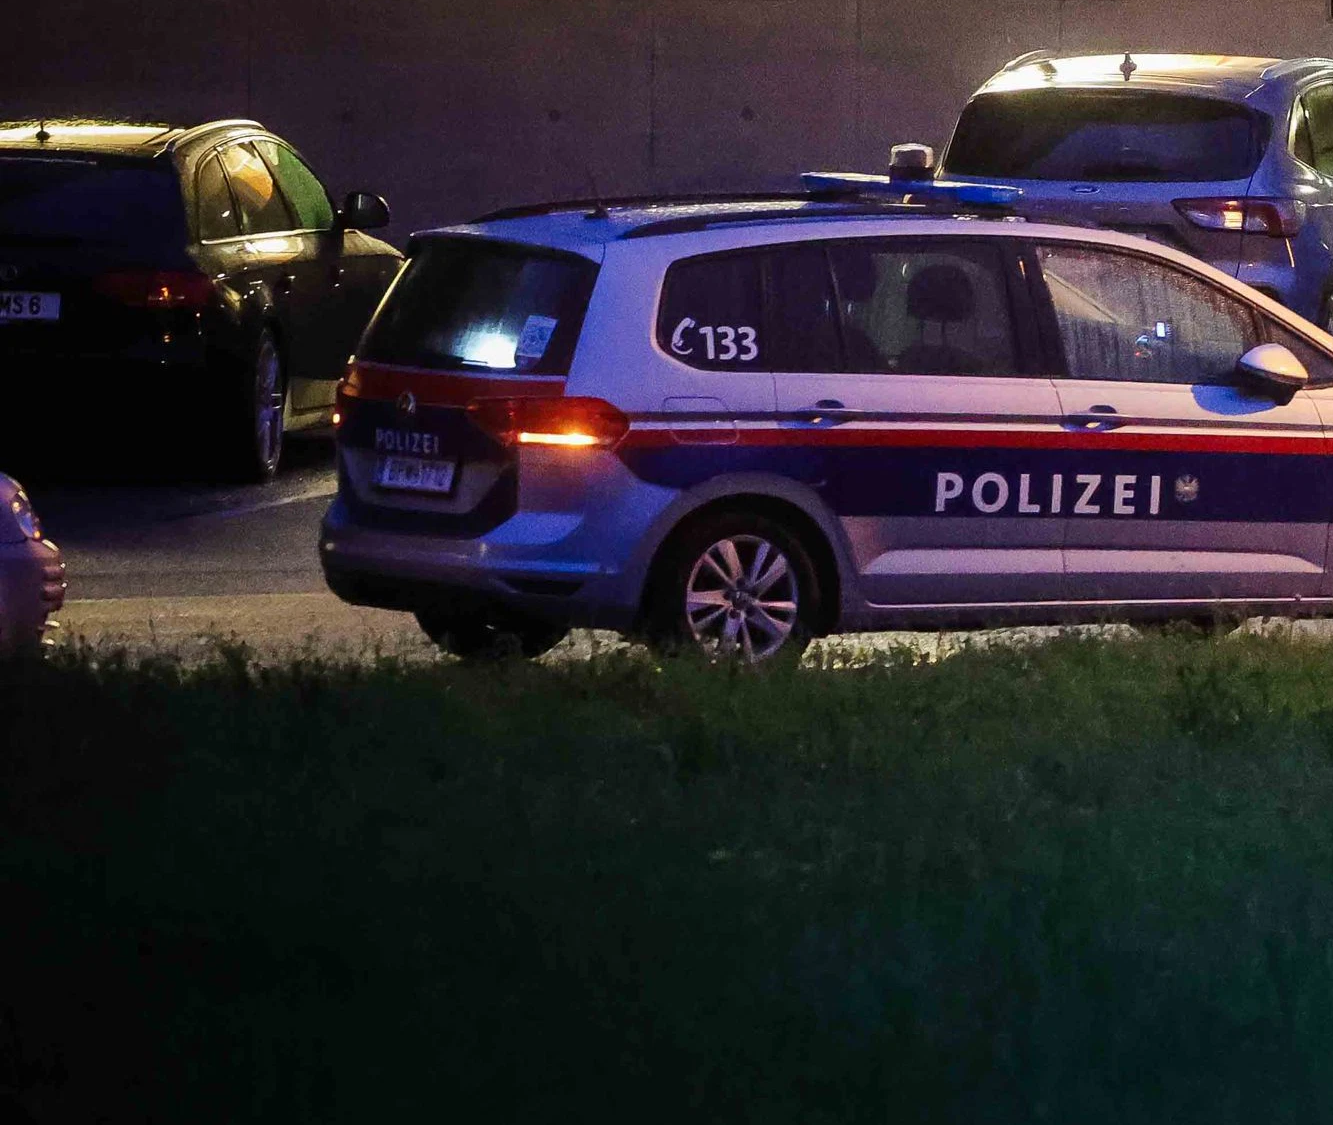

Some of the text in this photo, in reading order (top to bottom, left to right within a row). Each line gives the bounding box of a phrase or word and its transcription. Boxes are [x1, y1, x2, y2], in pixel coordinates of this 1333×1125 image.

[699, 326, 758, 361] 133
[375, 428, 440, 454] POLIZEI
[935, 472, 1161, 515] POLIZEI
